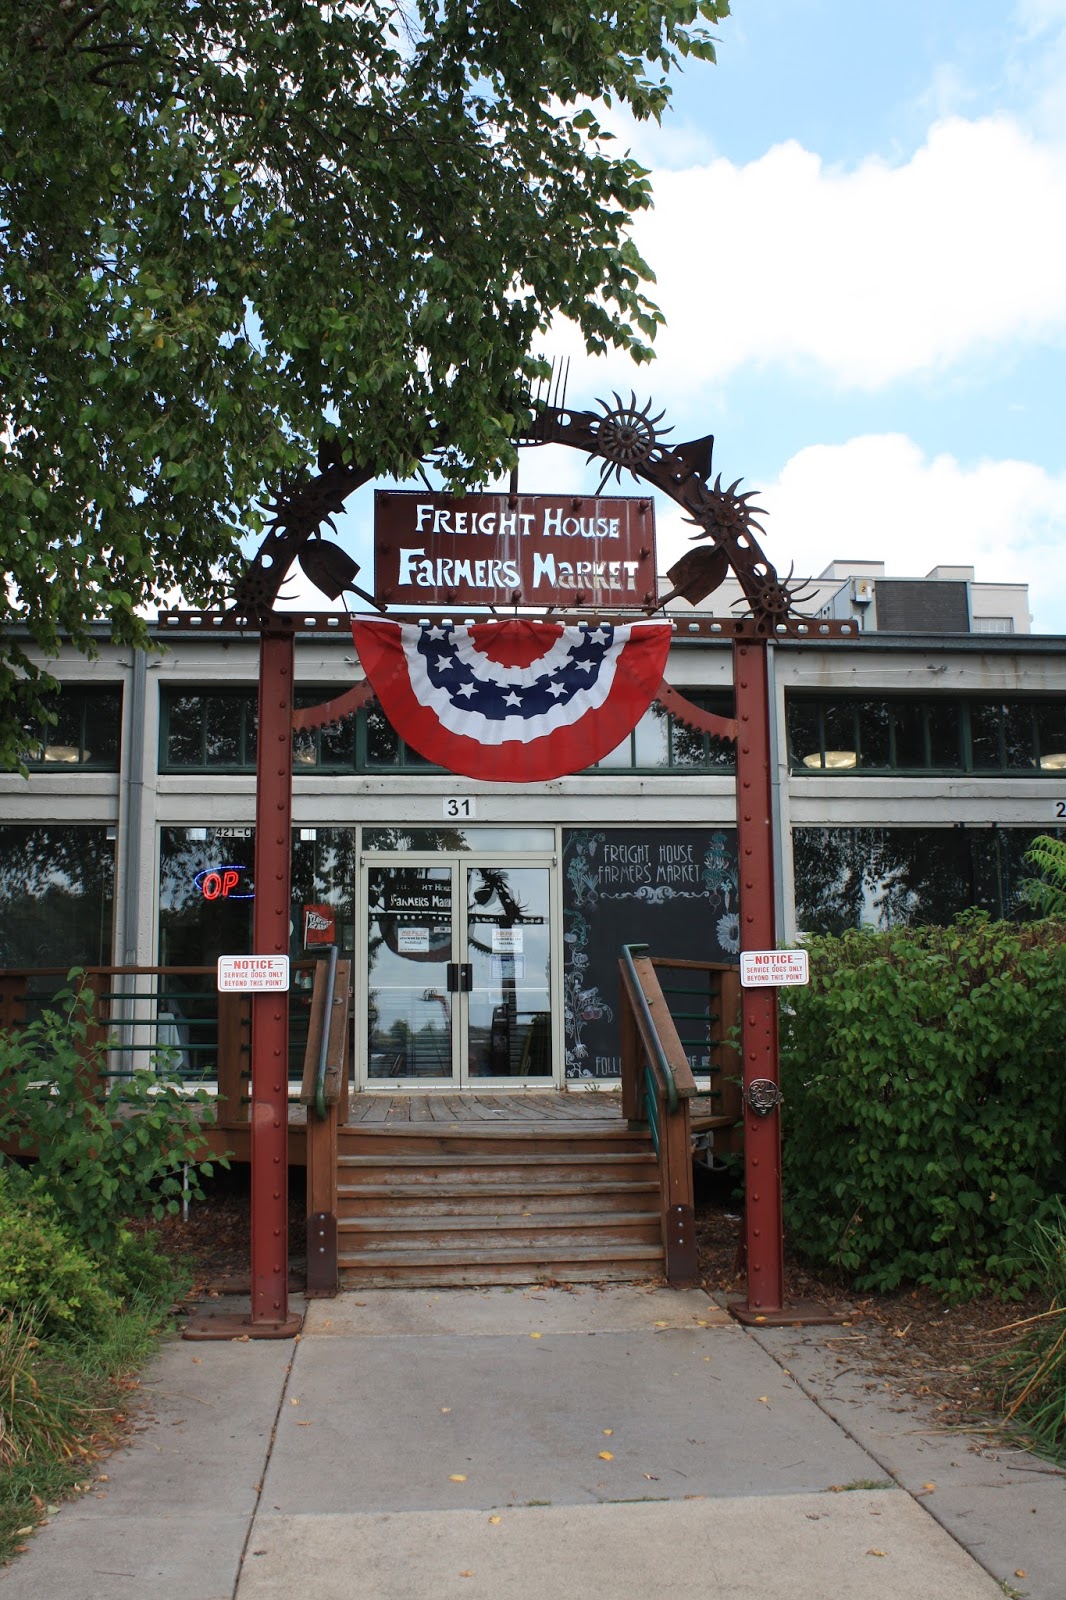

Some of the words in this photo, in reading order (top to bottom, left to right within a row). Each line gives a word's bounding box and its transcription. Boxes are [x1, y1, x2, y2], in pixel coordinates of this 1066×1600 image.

[415, 504, 536, 537] FREIGHT
[543, 508, 621, 539] HOUSE
[398, 548, 521, 589] FARMERS
[533, 552, 639, 591] MARKET
[447, 799, 470, 816] 31
[603, 844, 650, 864] FREIGHT
[659, 844, 694, 864] HOUSE
[656, 864, 700, 883] MARKET
[233, 960, 274, 970] NOTICE
[755, 954, 793, 964] NOTICE
[224, 971, 249, 979] SERVICE
[747, 966, 769, 974] SERVICE
[747, 974, 769, 982] BEYOND
